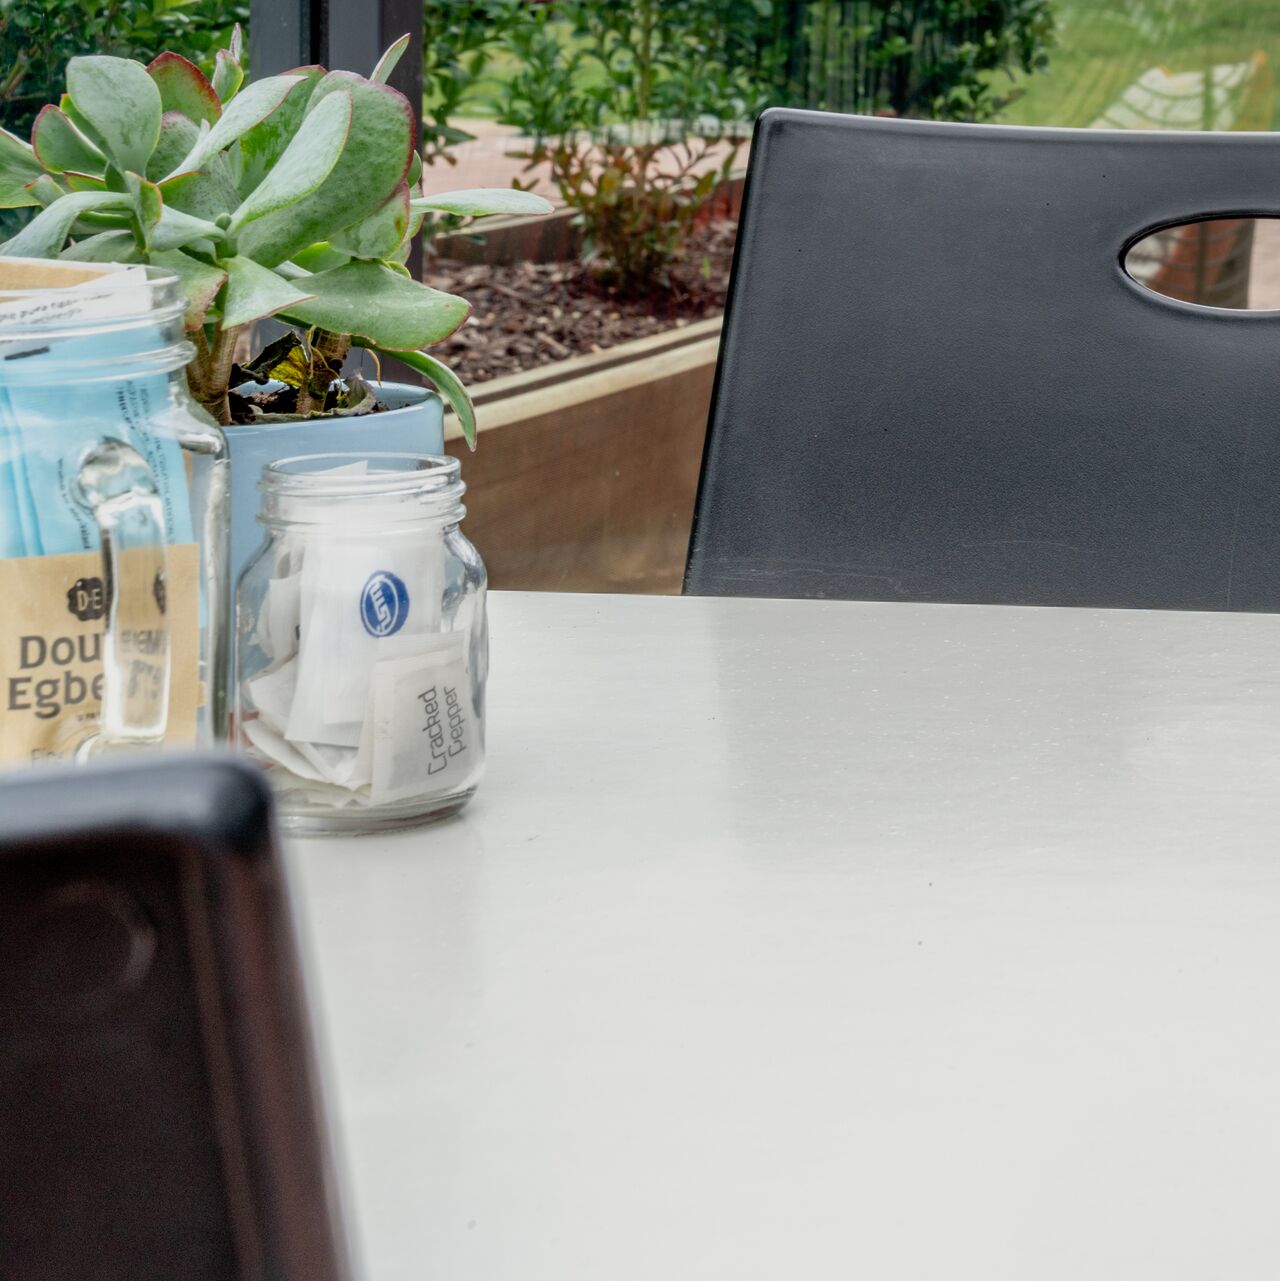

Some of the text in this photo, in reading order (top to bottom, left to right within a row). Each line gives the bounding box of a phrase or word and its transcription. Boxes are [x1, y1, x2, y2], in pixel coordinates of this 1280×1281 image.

[19, 633, 103, 669] Dou
[7, 671, 104, 720] Egbe
[417, 685, 448, 776] Cracked
